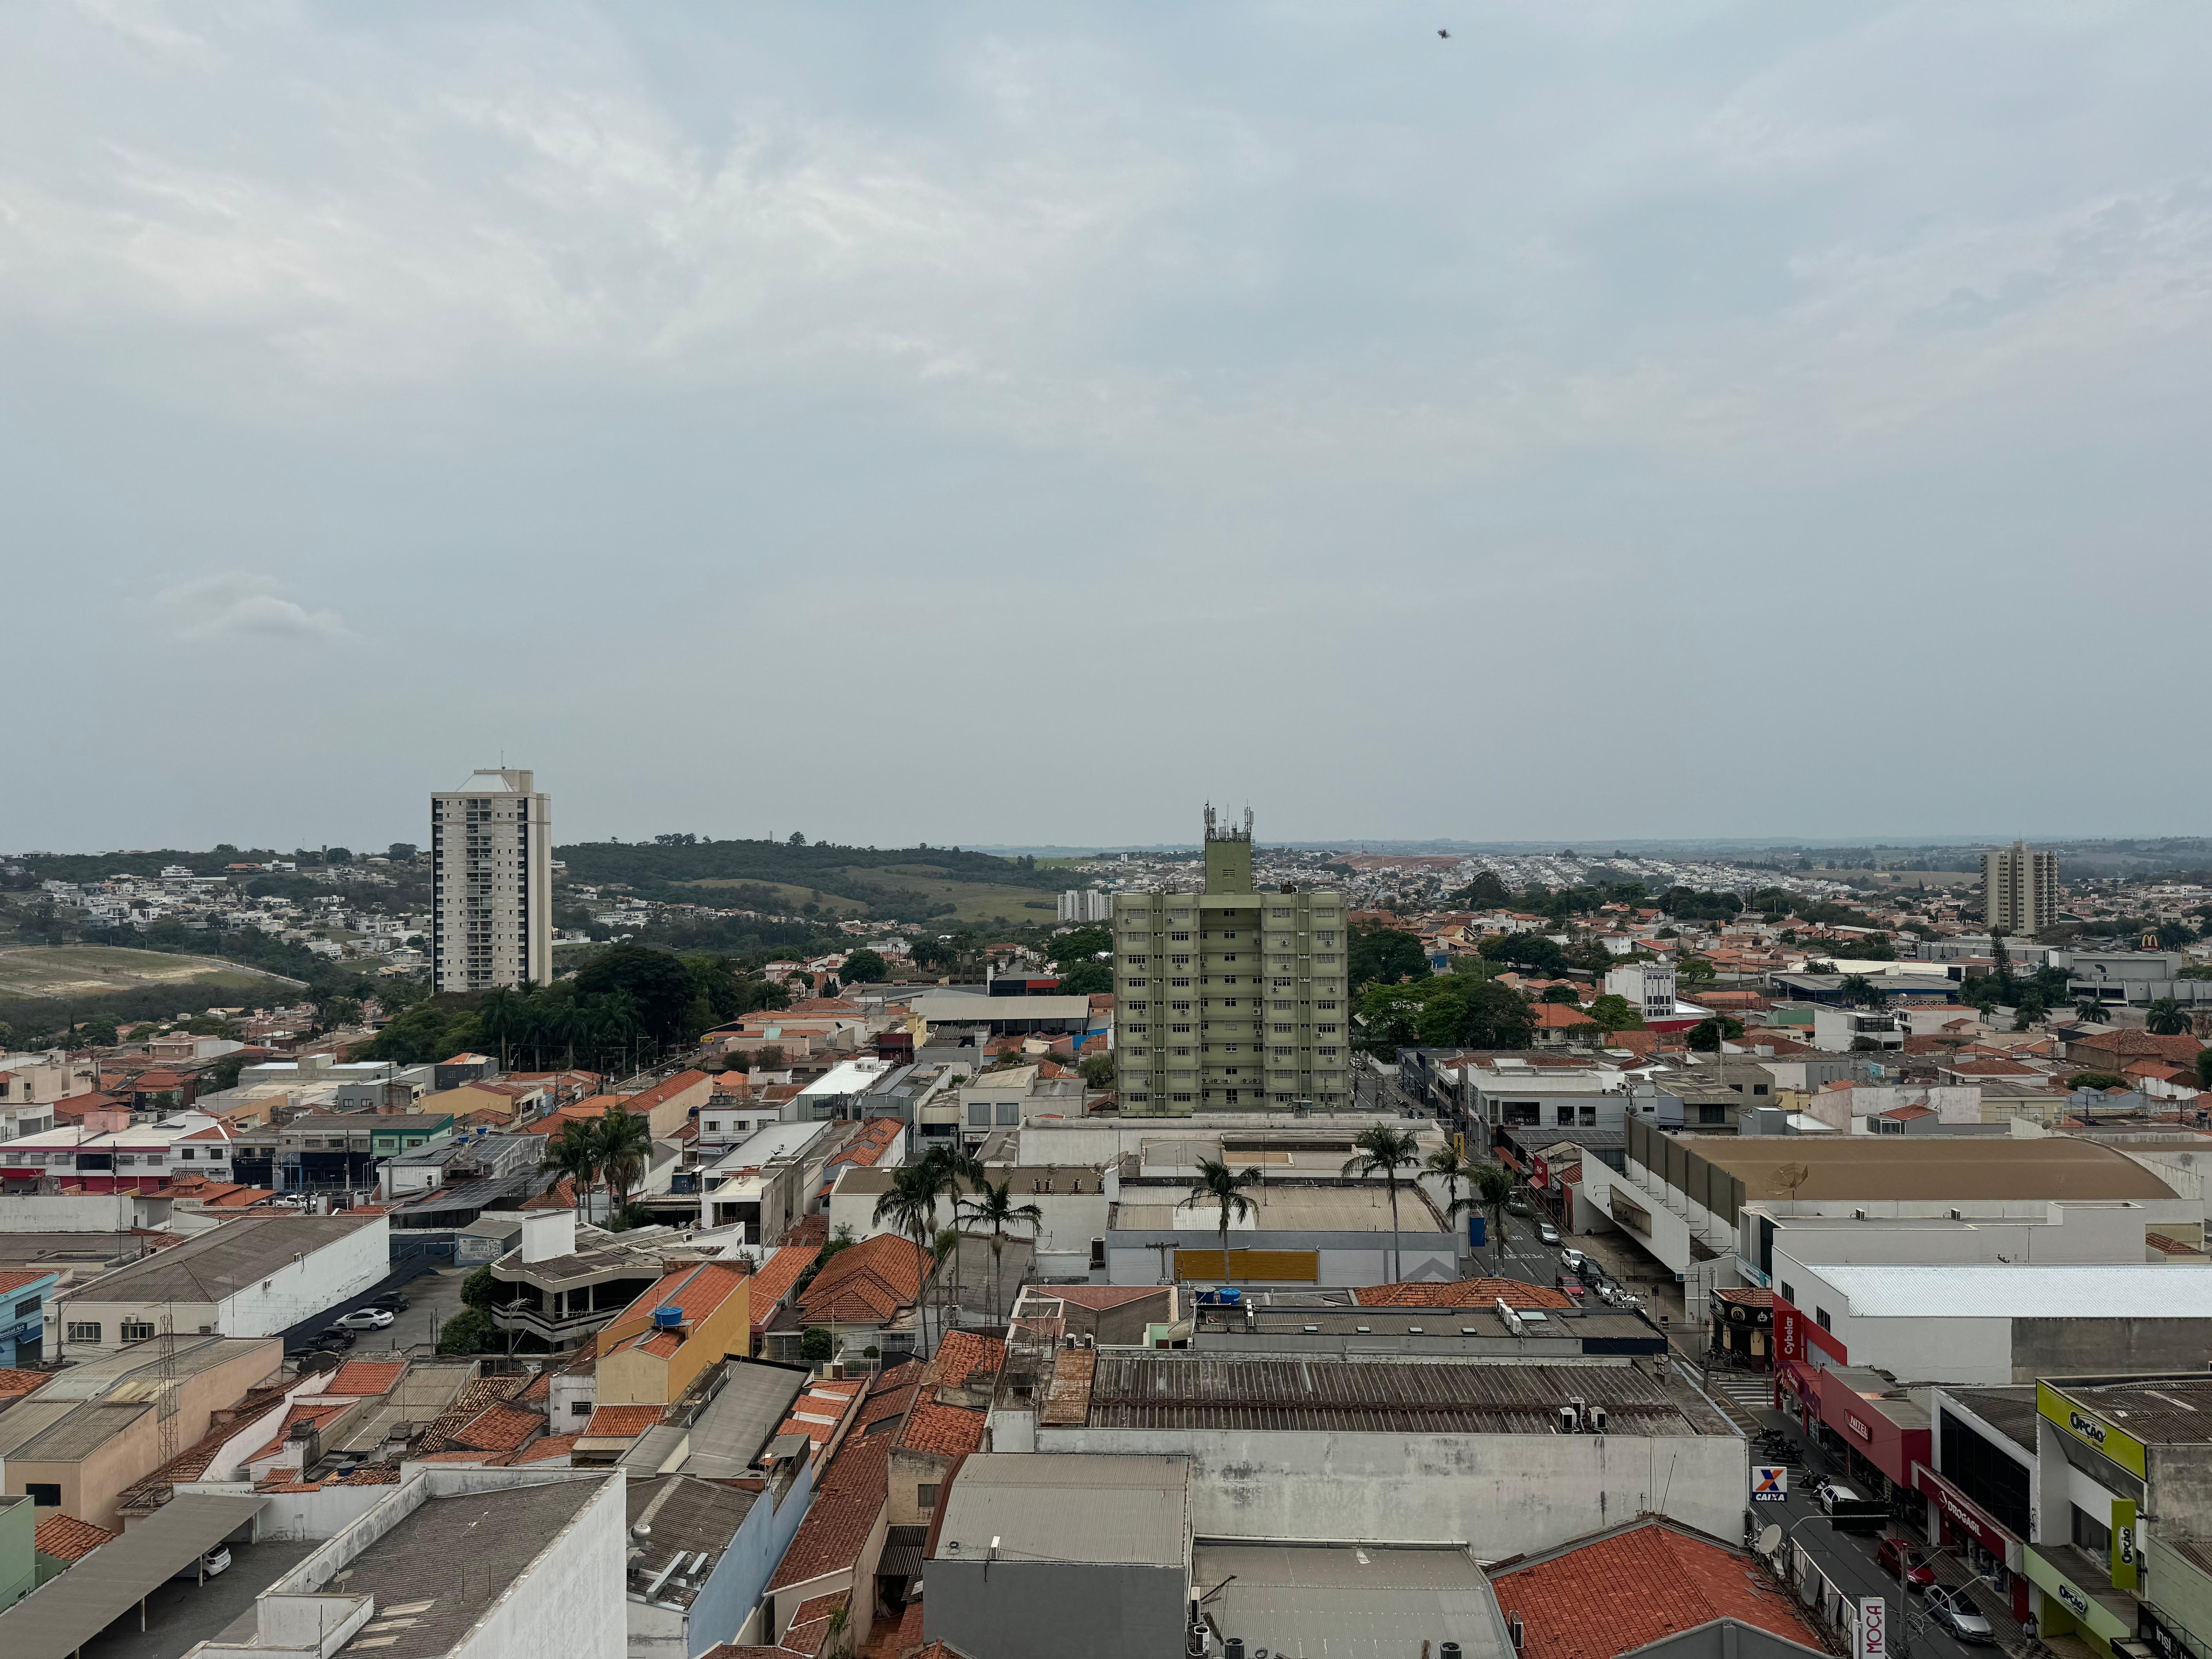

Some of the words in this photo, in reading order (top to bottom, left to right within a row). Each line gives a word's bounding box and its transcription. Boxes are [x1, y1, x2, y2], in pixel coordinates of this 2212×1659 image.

[1785, 1317, 1794, 1354] Cybelar
[1851, 1415, 1868, 1436] NITEL
[1948, 1501, 1982, 1536] DROGASIL
[1866, 1606, 1882, 1653] MOÇA
